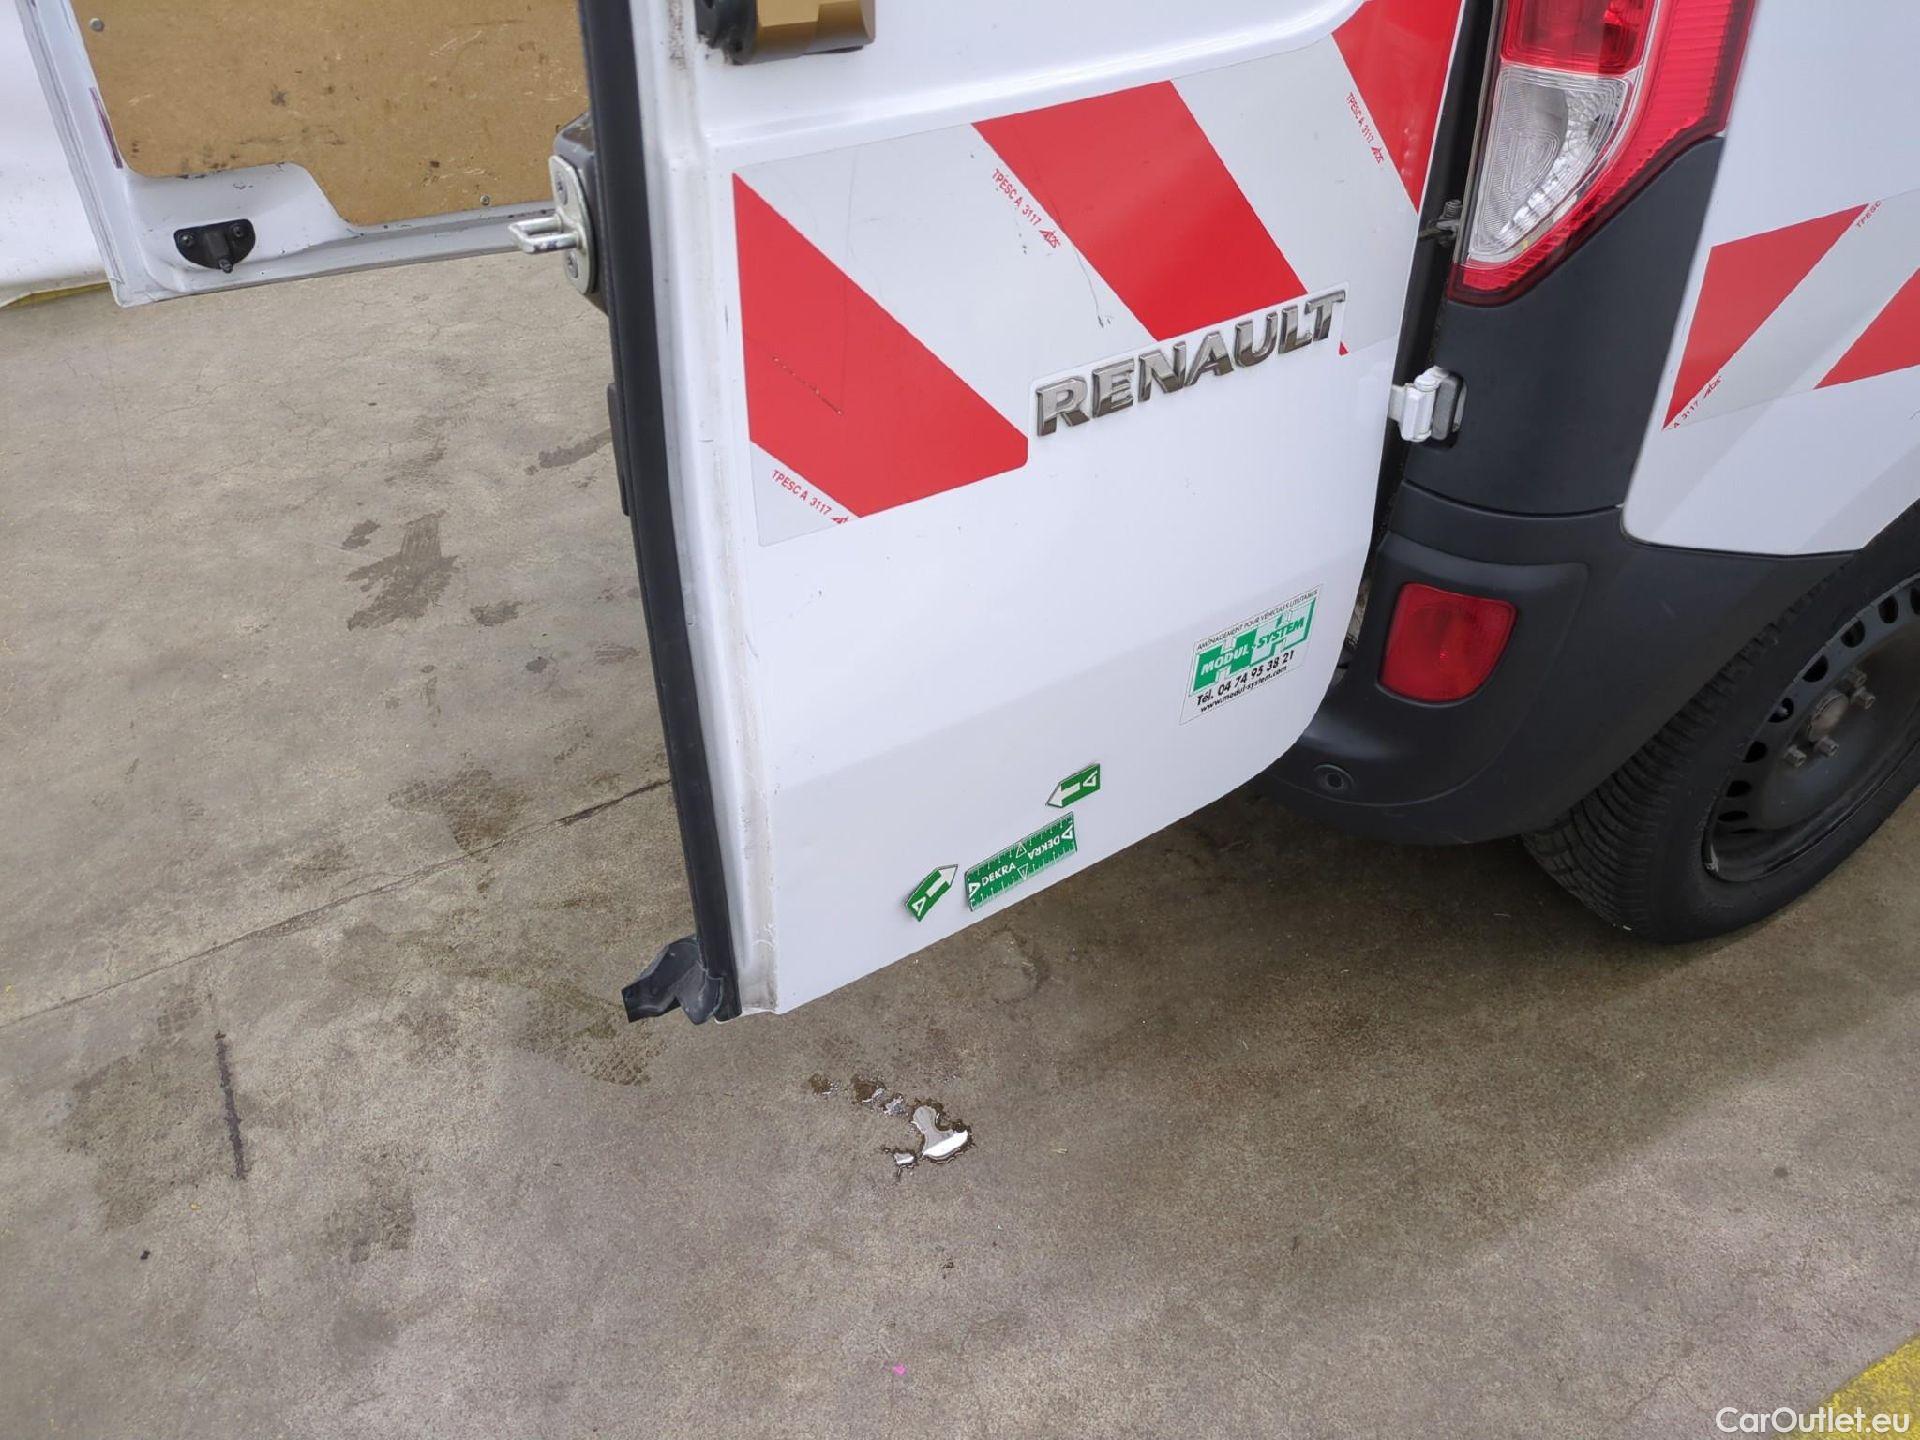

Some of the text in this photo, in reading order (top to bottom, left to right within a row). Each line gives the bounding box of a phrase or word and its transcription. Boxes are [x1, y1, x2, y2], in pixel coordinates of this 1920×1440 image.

[992, 168, 1017, 199] TPESC
[1014, 196, 1023, 208] A
[1022, 204, 1042, 226] 3117
[1036, 289, 1346, 437] RENAULT
[772, 469, 832, 515] TPESC A 3117
[1217, 680, 1232, 697] 04
[1234, 672, 1248, 688] 74
[1251, 665, 1264, 678] 95
[1266, 656, 1280, 671] 38
[1283, 650, 1295, 665] 21
[1027, 834, 1060, 860] DEKRA
[981, 862, 1017, 888] DEKRA
